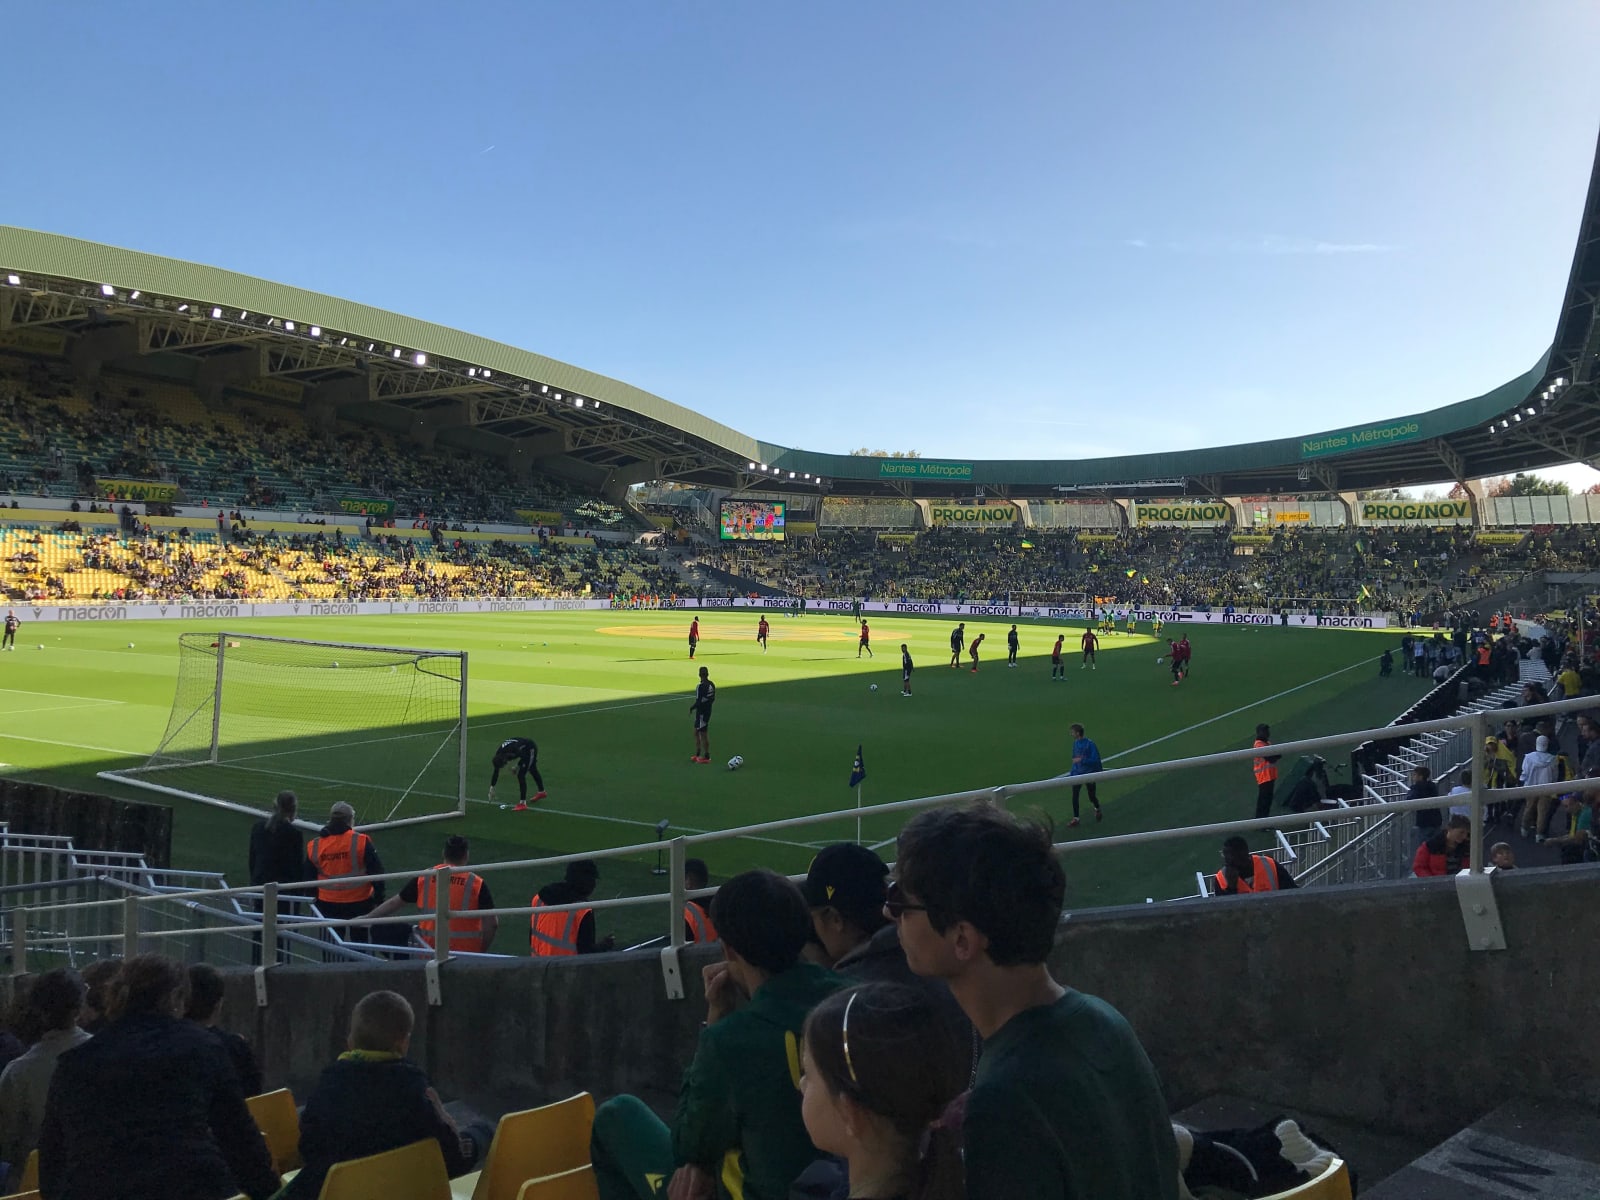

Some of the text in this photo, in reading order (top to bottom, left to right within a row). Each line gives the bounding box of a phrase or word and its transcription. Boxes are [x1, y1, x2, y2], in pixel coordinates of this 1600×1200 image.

[1302, 423, 1418, 452] Nantes Métropole
[881, 463, 972, 476] Nantes Métropole
[310, 602, 358, 615] macron
[418, 602, 458, 612] macron
[490, 602, 526, 612] macron
[554, 600, 585, 610] macron
[828, 600, 864, 610] macrn
[896, 603, 936, 613] macron
[58, 606, 126, 620] macron
[180, 605, 238, 618] macron
[970, 606, 1012, 615] macron
[1222, 613, 1273, 624] macron
